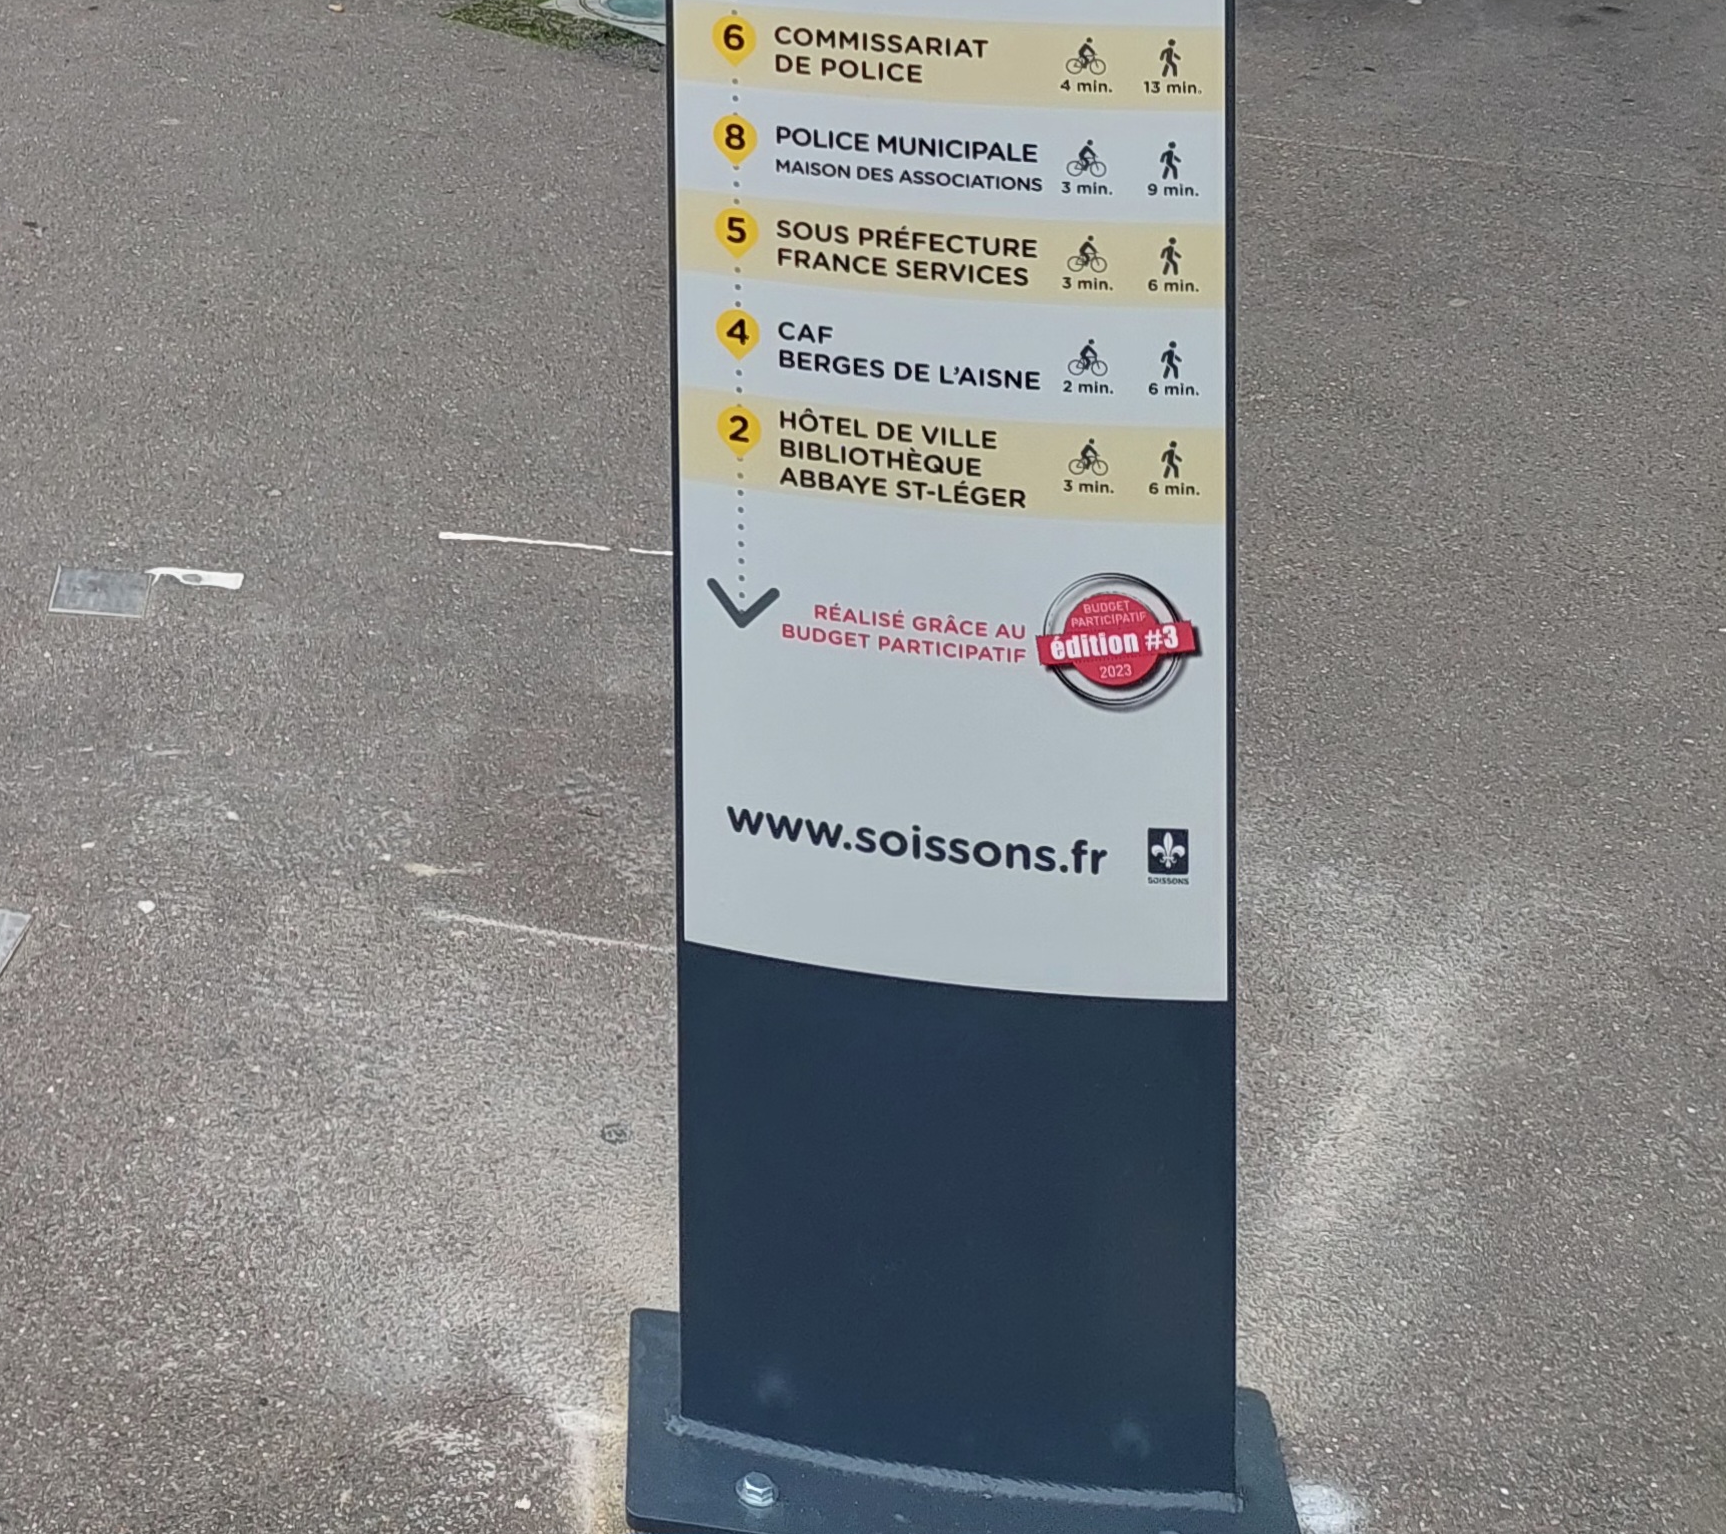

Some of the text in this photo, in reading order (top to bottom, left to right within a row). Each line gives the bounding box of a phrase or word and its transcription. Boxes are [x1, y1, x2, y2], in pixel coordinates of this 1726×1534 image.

[724, 24, 744, 50] 6
[775, 26, 988, 59] COMMISSARIAT
[776, 54, 922, 83] DE POLICE
[1061, 80, 1112, 92] 4 min.
[1144, 81, 1202, 95] 13 min.
[726, 124, 745, 150] 8
[777, 126, 1037, 162] POLICE MUNICIPALE
[776, 159, 1042, 191] MAISON DES ASSOCIATIONS
[1062, 182, 1112, 195] 3 min.
[1148, 184, 1198, 196] 9 min.
[727, 217, 746, 243] 5
[777, 220, 1037, 259] SOUS PRÉFECTURE
[778, 248, 1028, 286] FRANCE SERVICES
[1063, 277, 1112, 290] 3 min.
[1148, 279, 1199, 292] 6 min.
[727, 319, 748, 345] 4
[779, 322, 832, 343] CAF
[780, 350, 884, 378] BERGES
[895, 362, 929, 382] DE
[1063, 380, 1113, 394] 2 min.
[1149, 383, 1198, 395] 6 min.
[730, 416, 749, 442] 2
[780, 408, 996, 449] HÔTEL DE VILLE
[781, 436, 981, 480] BIBLIOTHÈQUE
[780, 468, 1025, 508] ABBAYE ST-LÉGER
[1064, 480, 1113, 493] 3 min.
[1149, 483, 1199, 495] 6 min.
[1071, 611, 1147, 628] PARTICIPATIF
[1083, 600, 1130, 614] BUDGET
[813, 603, 1025, 639] RÉALISÉ GRÂCE AU
[783, 621, 1026, 662] BUDGET PARTICIPATIF
[1050, 625, 1179, 661] édition #3
[1099, 665, 1132, 678] 2023
[727, 806, 1107, 874] www.soissons.fr
[1148, 877, 1189, 885] SOISSONS
